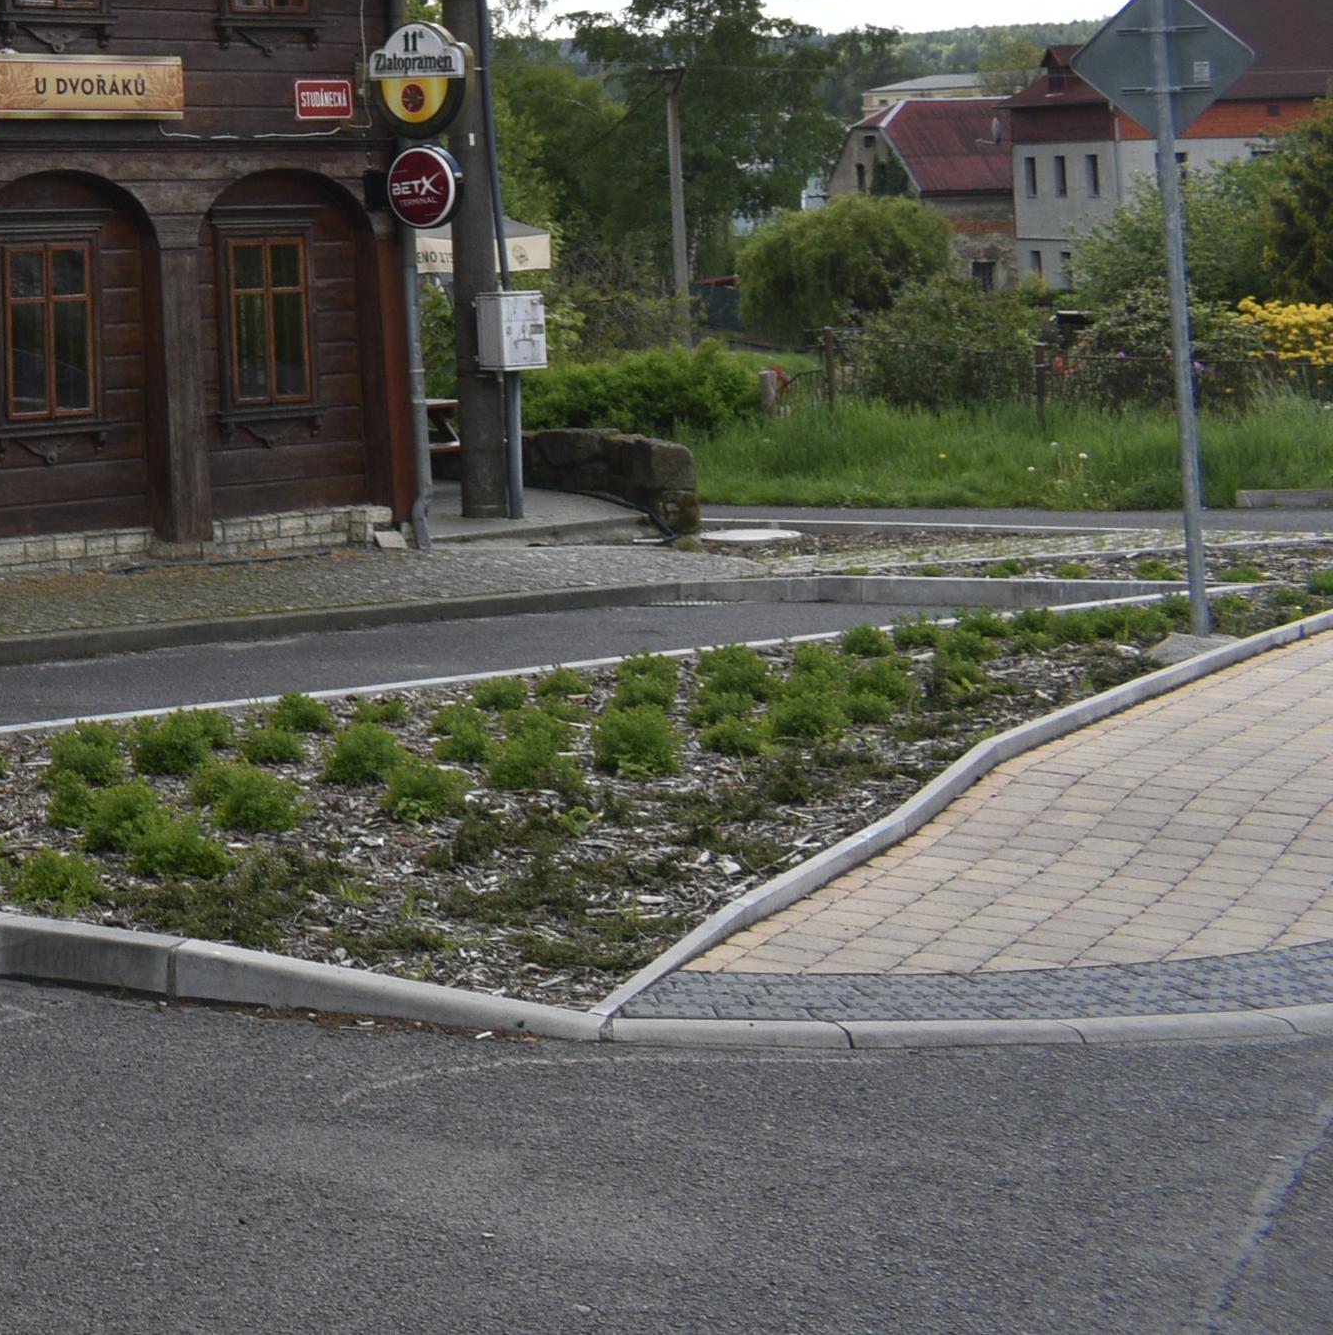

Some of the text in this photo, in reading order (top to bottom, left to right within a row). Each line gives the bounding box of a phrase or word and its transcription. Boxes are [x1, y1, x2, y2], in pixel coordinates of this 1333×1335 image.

[374, 53, 452, 74] Zlatopramen
[34, 74, 146, 96] U DVOŘÁKŮ
[300, 87, 348, 107] STUDÁNECKÁ
[399, 196, 437, 207] TERMINAL
